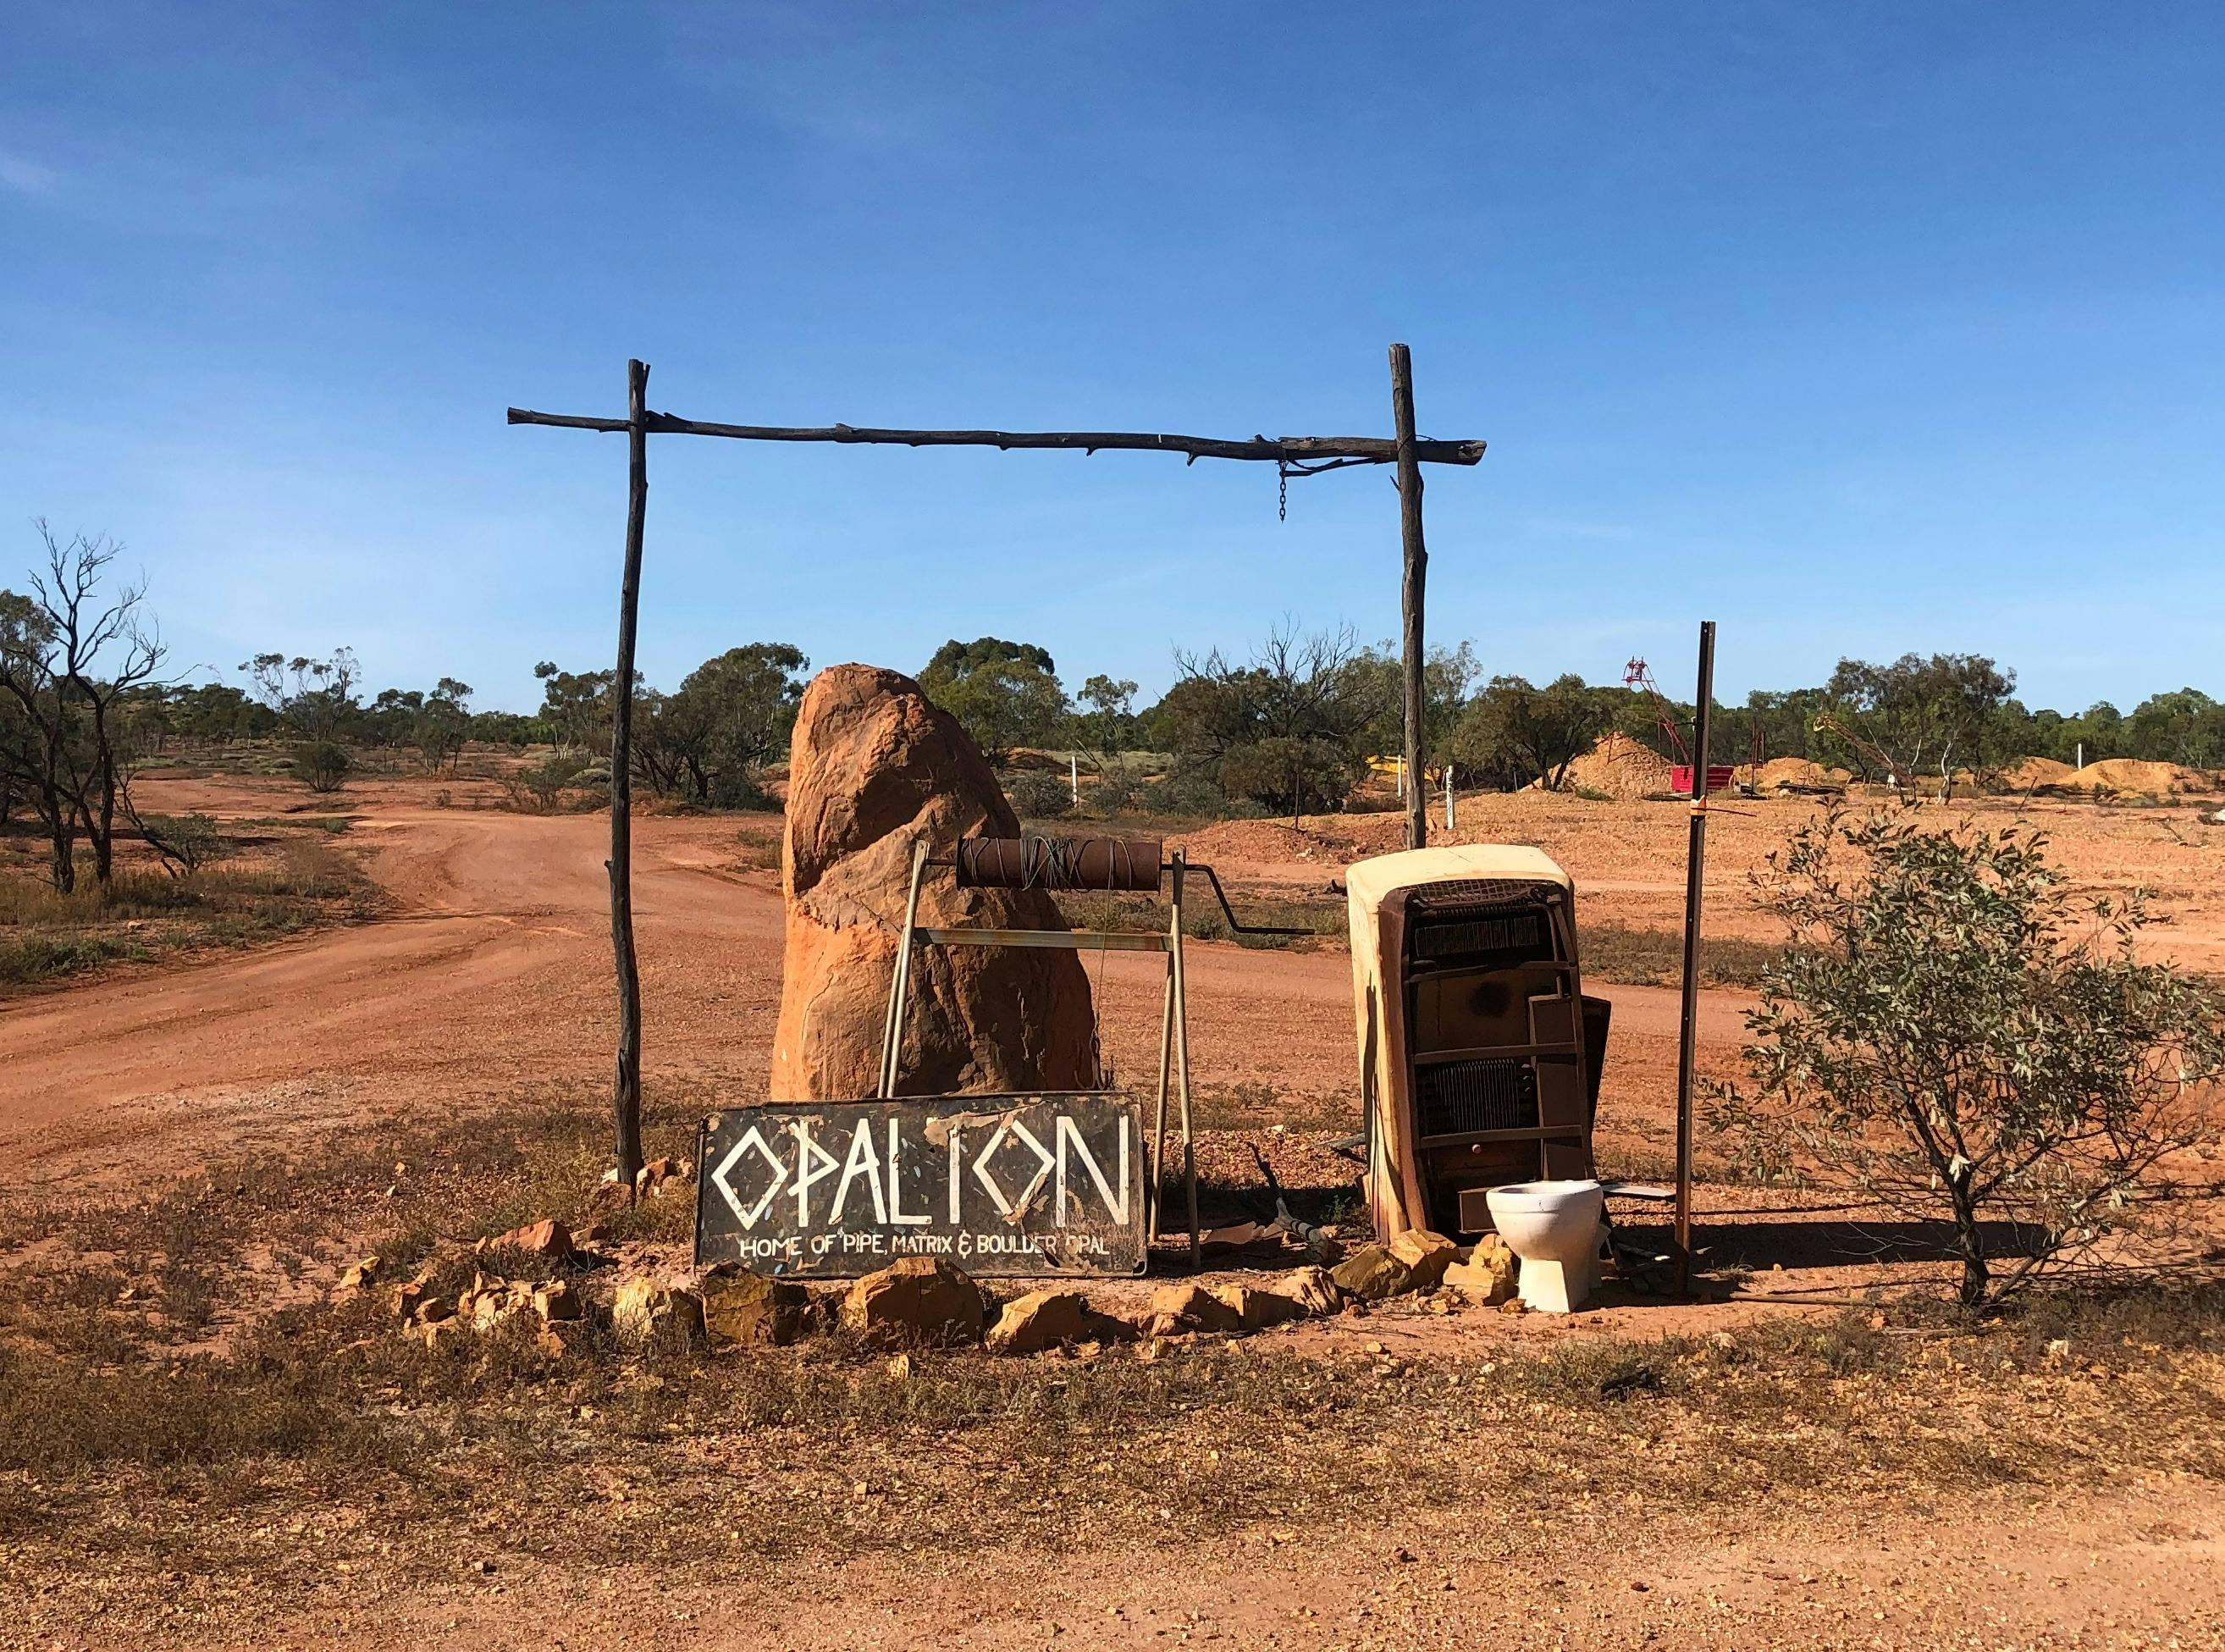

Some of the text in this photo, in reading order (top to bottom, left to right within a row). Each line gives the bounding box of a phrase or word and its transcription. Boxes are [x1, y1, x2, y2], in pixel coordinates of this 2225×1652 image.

[740, 1236, 803, 1257] HOME
[811, 1235, 836, 1254] OF
[892, 1235, 952, 1254] MATRIX
[958, 1229, 972, 1259] &
[977, 1235, 1057, 1255] BOULDER
